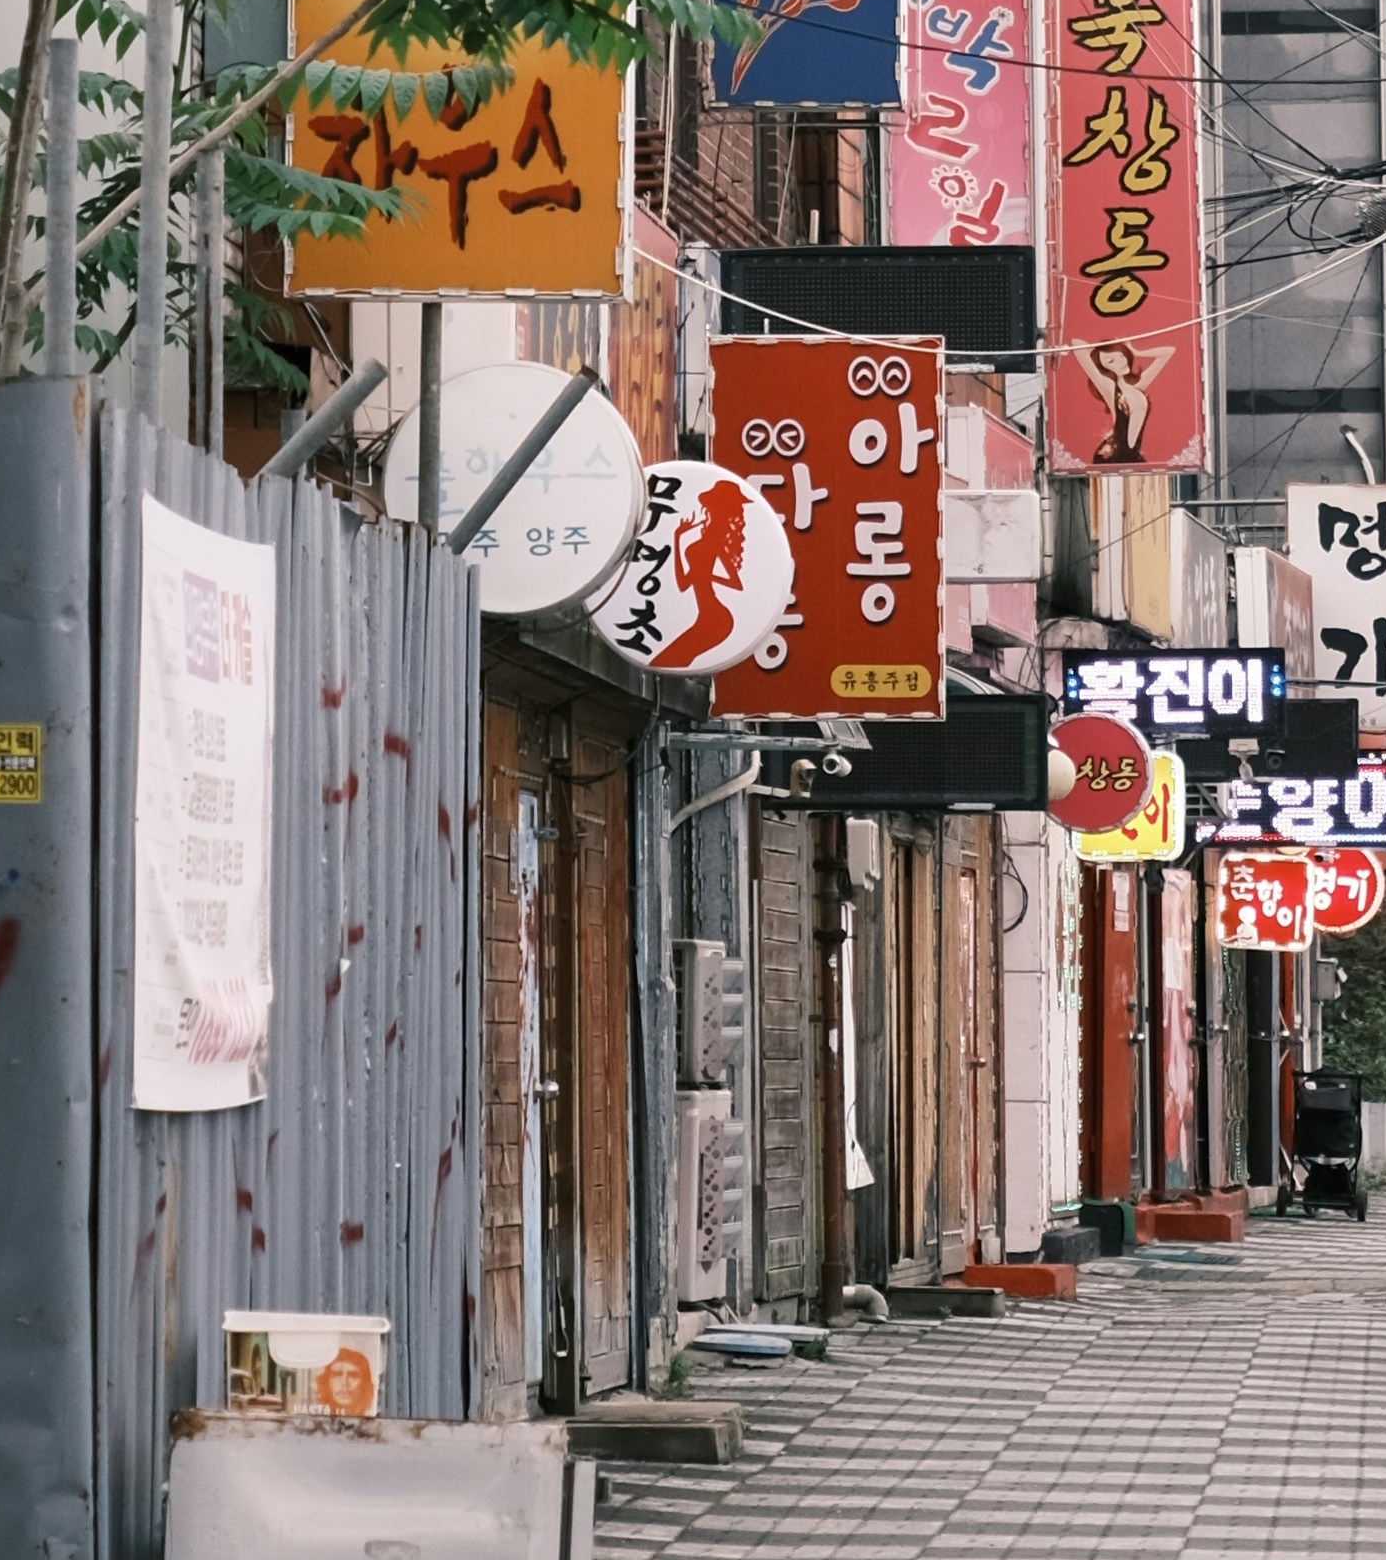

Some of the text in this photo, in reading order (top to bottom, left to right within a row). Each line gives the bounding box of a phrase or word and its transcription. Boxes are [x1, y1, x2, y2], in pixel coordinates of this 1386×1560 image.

[526, 526, 591, 557] 양주
[846, 402, 935, 623] 아롱
[840, 670, 920, 692] 유흥주점
[1077, 658, 1264, 723] 황진이
[1229, 865, 1304, 941] 춘향이
